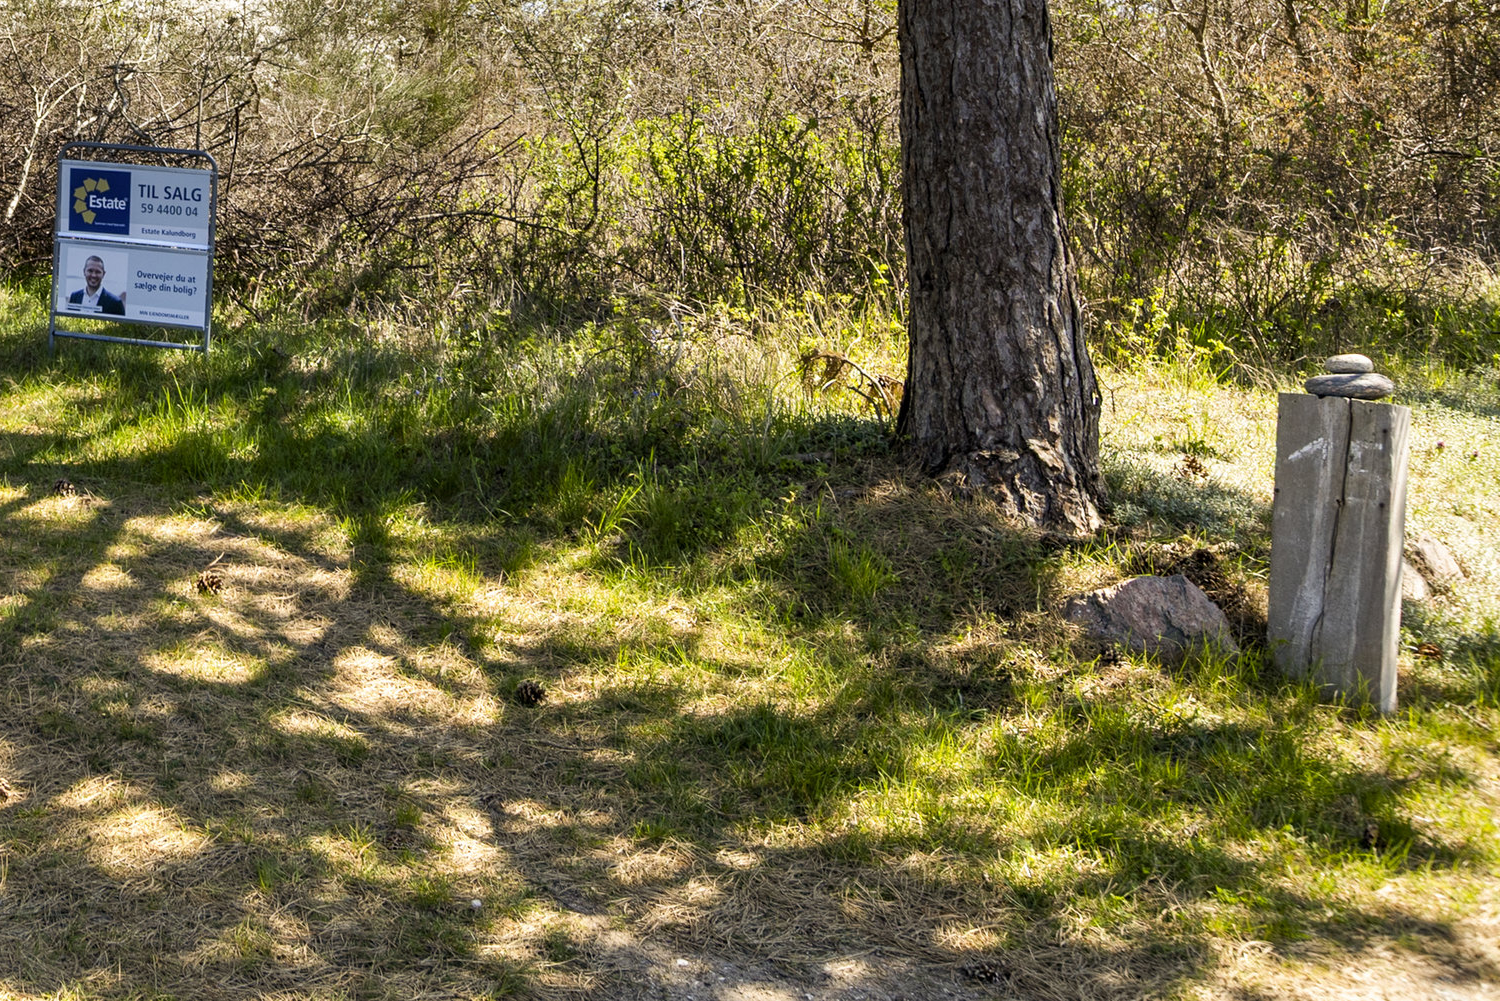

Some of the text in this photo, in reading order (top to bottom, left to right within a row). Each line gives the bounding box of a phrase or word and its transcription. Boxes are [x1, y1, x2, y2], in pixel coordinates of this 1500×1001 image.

[138, 184, 202, 202] TIL SALG
[89, 194, 126, 210] Estate
[141, 203, 198, 217] 59 4400 04
[141, 227, 196, 239] Estate Kalundborg
[136, 270, 196, 284] Overvejer du at
[134, 281, 197, 297] sælge din bolig?
